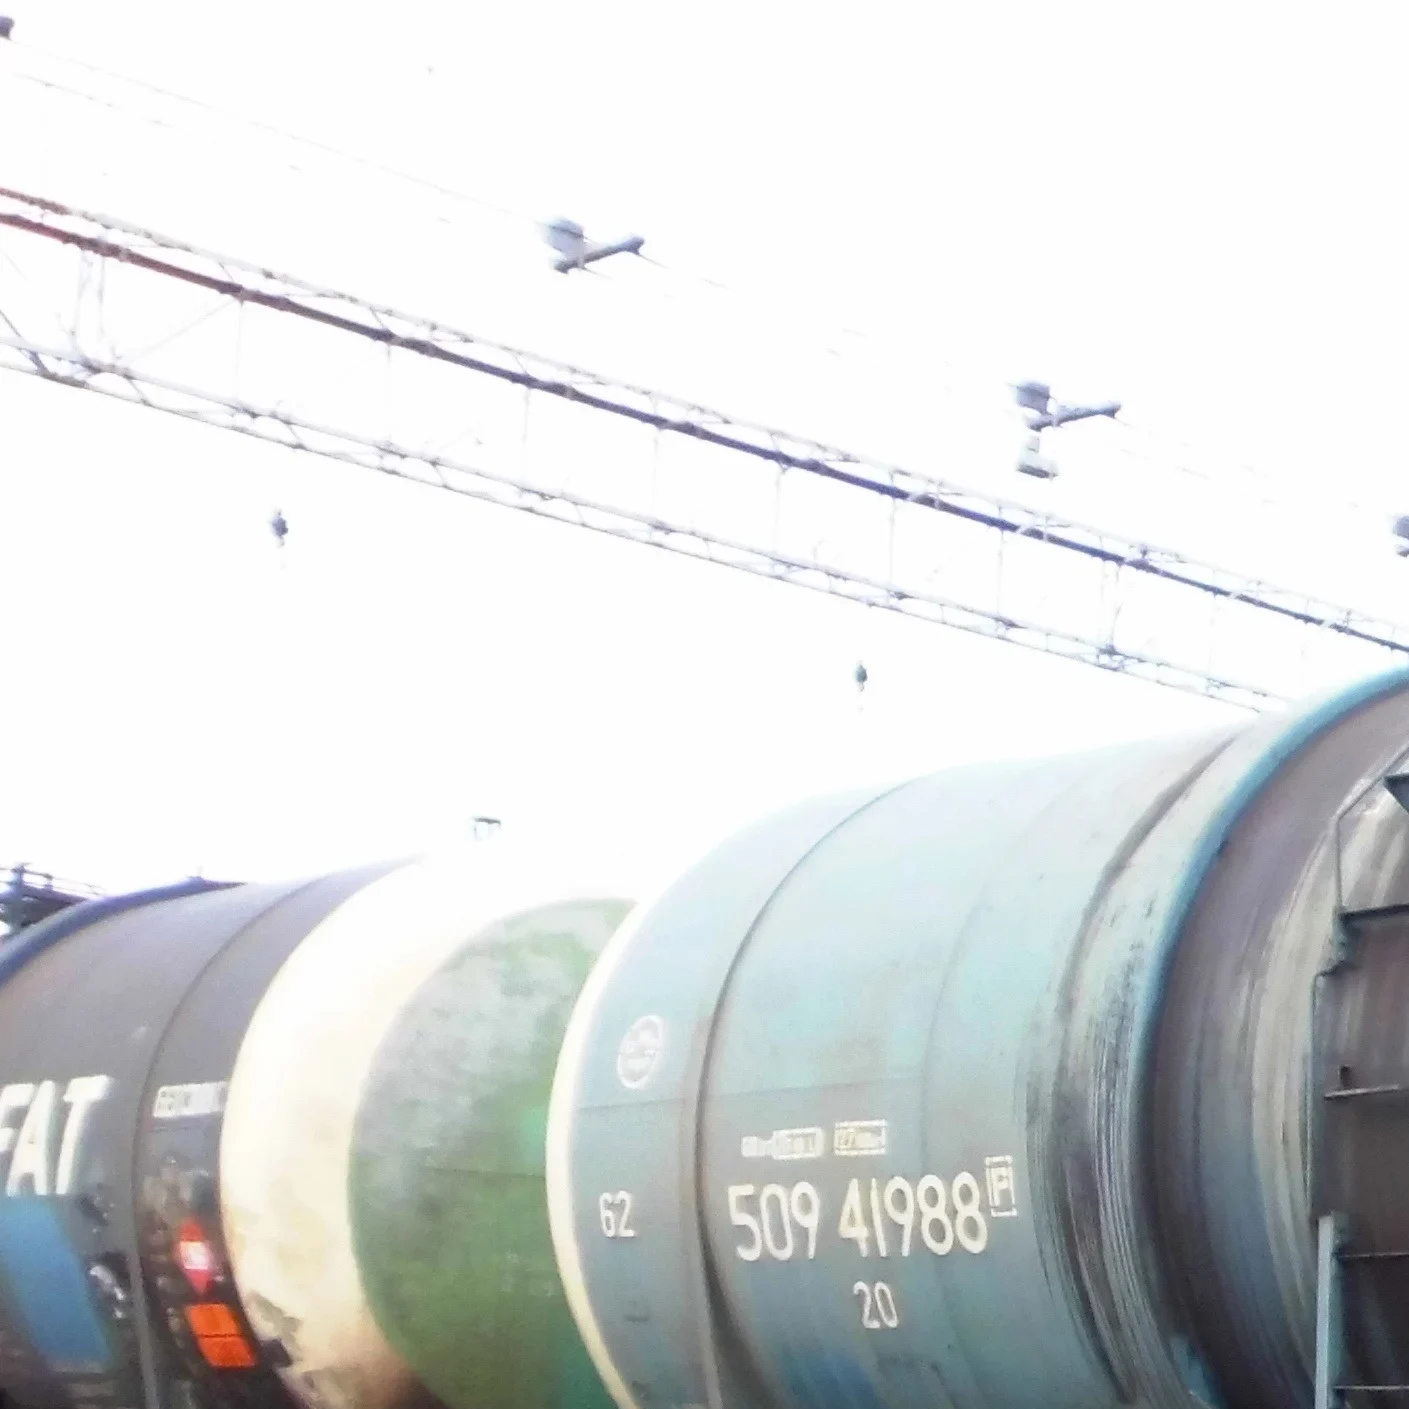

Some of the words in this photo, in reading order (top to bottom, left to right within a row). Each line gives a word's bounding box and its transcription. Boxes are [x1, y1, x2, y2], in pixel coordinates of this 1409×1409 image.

[600, 1191, 639, 1238] 62
[728, 1182, 820, 1261] 509
[838, 1171, 989, 1257] 41988
[853, 1281, 898, 1329] 20
